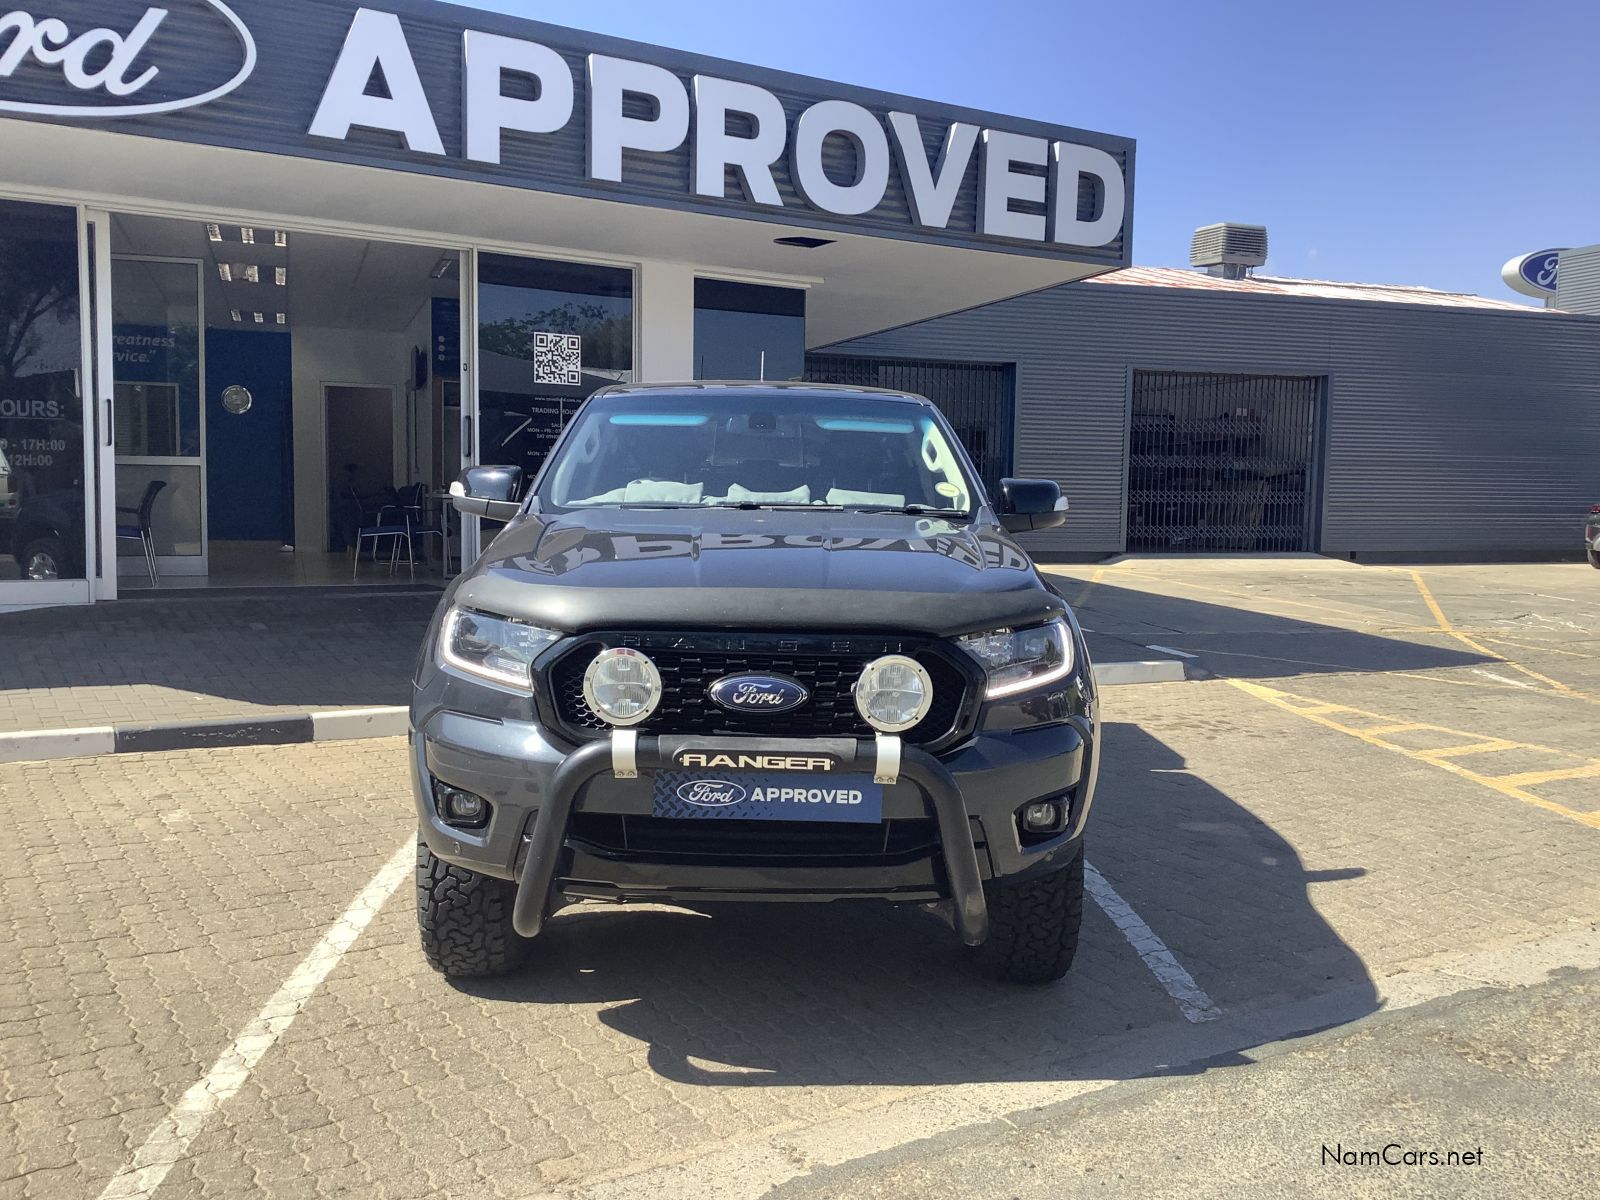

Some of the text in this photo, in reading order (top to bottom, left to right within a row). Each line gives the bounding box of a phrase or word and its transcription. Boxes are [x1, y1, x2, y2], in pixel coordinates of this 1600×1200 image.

[308, 7, 1126, 249] APPROVED
[733, 682, 785, 704] Ford
[683, 754, 831, 771] RANGER
[688, 782, 863, 804] Ford APPROVED
